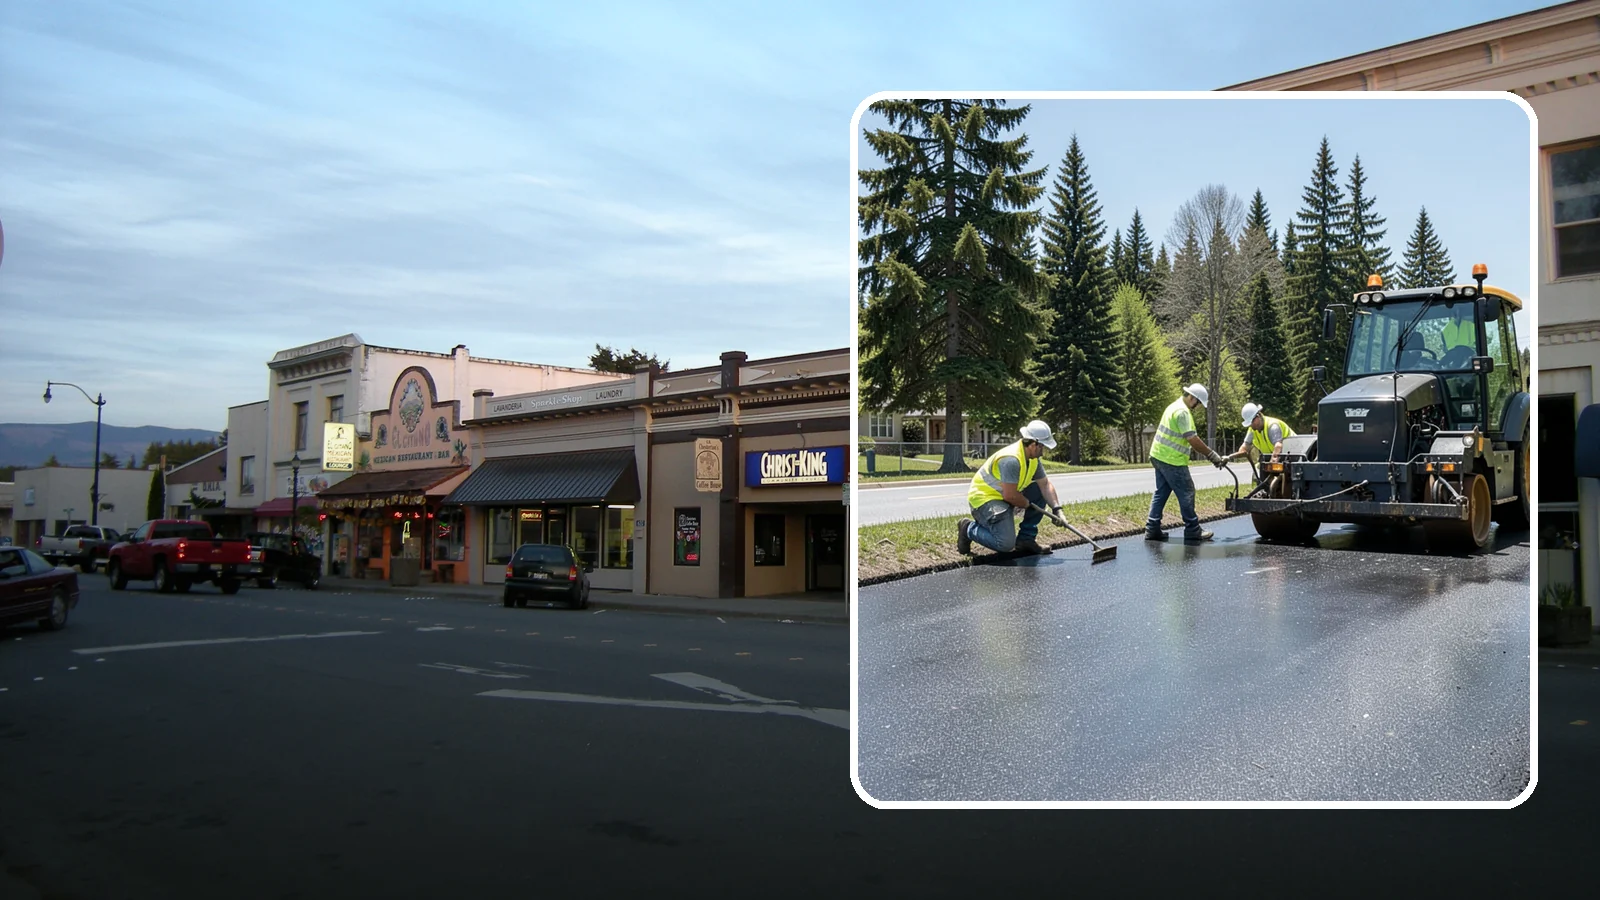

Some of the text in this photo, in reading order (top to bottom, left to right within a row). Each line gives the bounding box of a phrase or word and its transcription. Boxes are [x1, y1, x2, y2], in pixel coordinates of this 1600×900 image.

[595, 389, 624, 400] LAUNDRY
[493, 402, 523, 413] LAVANDERIA
[530, 394, 583, 409] Sparkle Shop
[327, 450, 352, 458] MEXICAN
[373, 454, 396, 464] MEXICAN
[397, 451, 434, 462] RESTAURANT
[437, 450, 450, 459] BAR
[760, 450, 828, 478] CHRIST KING
